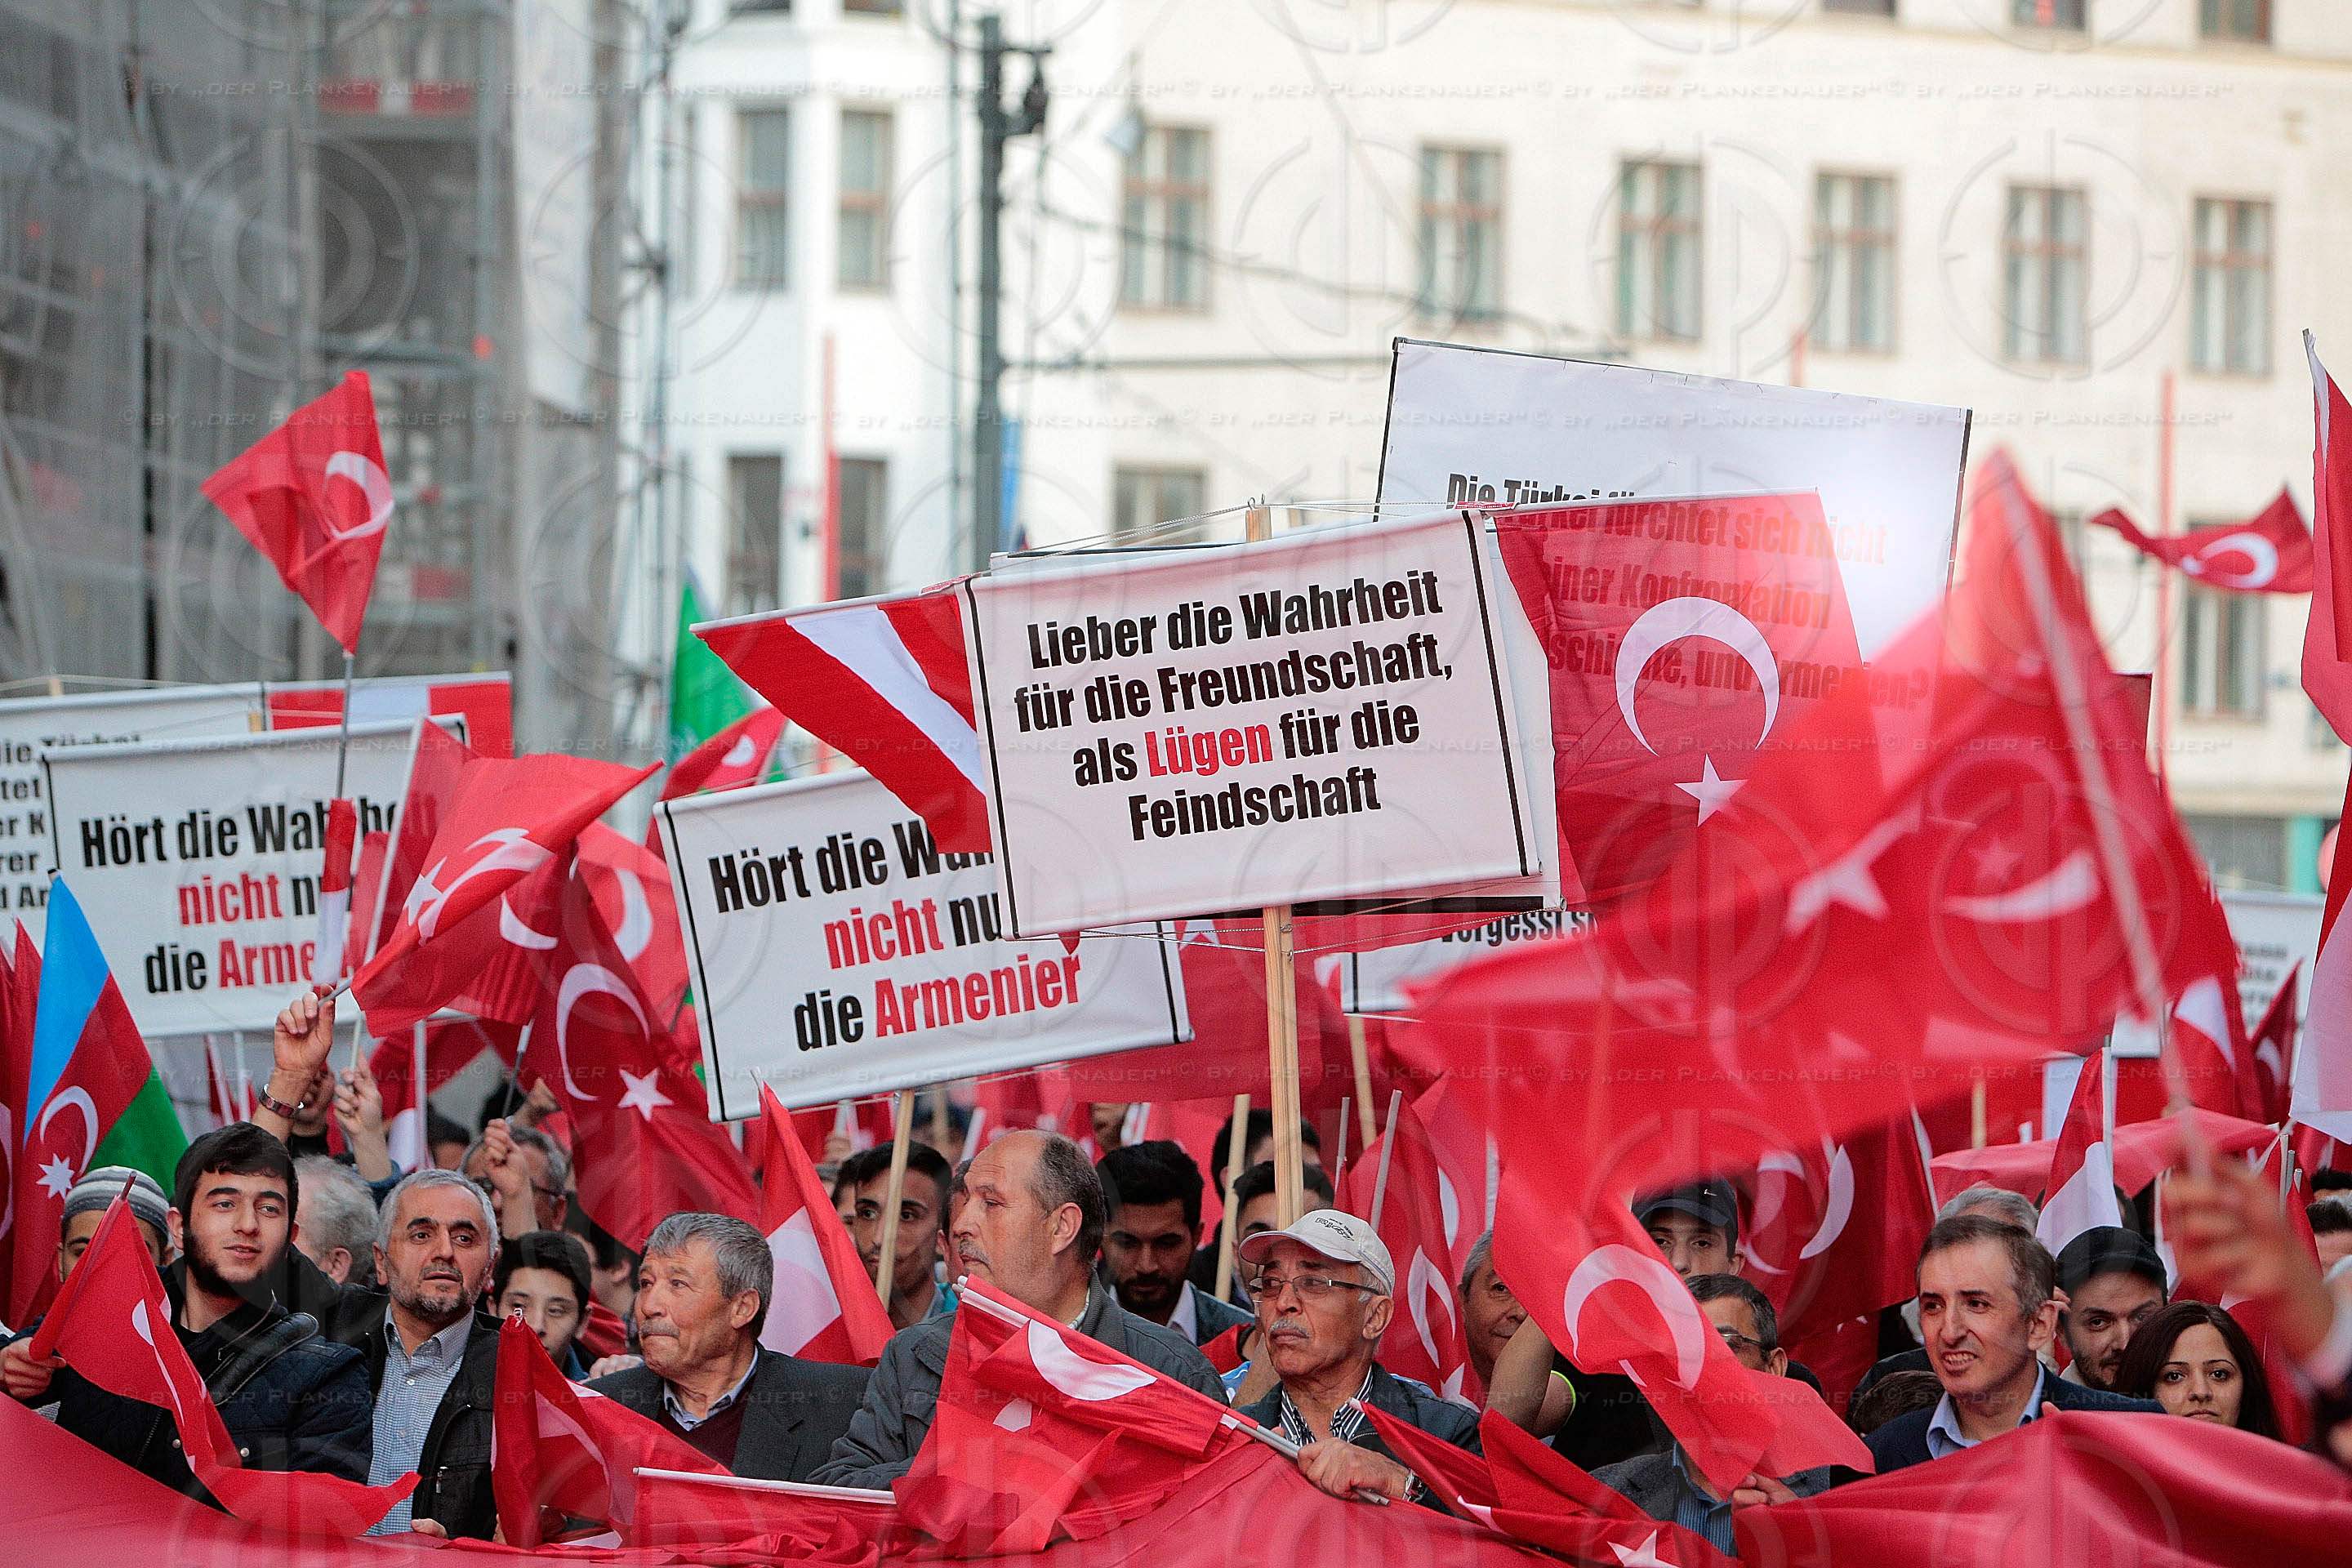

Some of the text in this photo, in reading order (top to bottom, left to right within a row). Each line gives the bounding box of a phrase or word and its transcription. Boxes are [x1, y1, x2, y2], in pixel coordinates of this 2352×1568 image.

[1734, 506, 1802, 556] sich
[1027, 570, 1444, 670] Lieber die Wahrheit
[1013, 632, 1452, 733] für die Freundschaft,
[1073, 700, 1420, 787] als Lügen für die
[80, 813, 167, 868] Hört
[177, 811, 238, 861] die
[1128, 766, 1383, 842] Feindschaft
[177, 871, 283, 928] nicht
[707, 845, 811, 914] Hört
[816, 831, 888, 894] die
[144, 943, 207, 995] die
[823, 898, 944, 970] nicht
[794, 954, 1081, 1052] die Armenier
